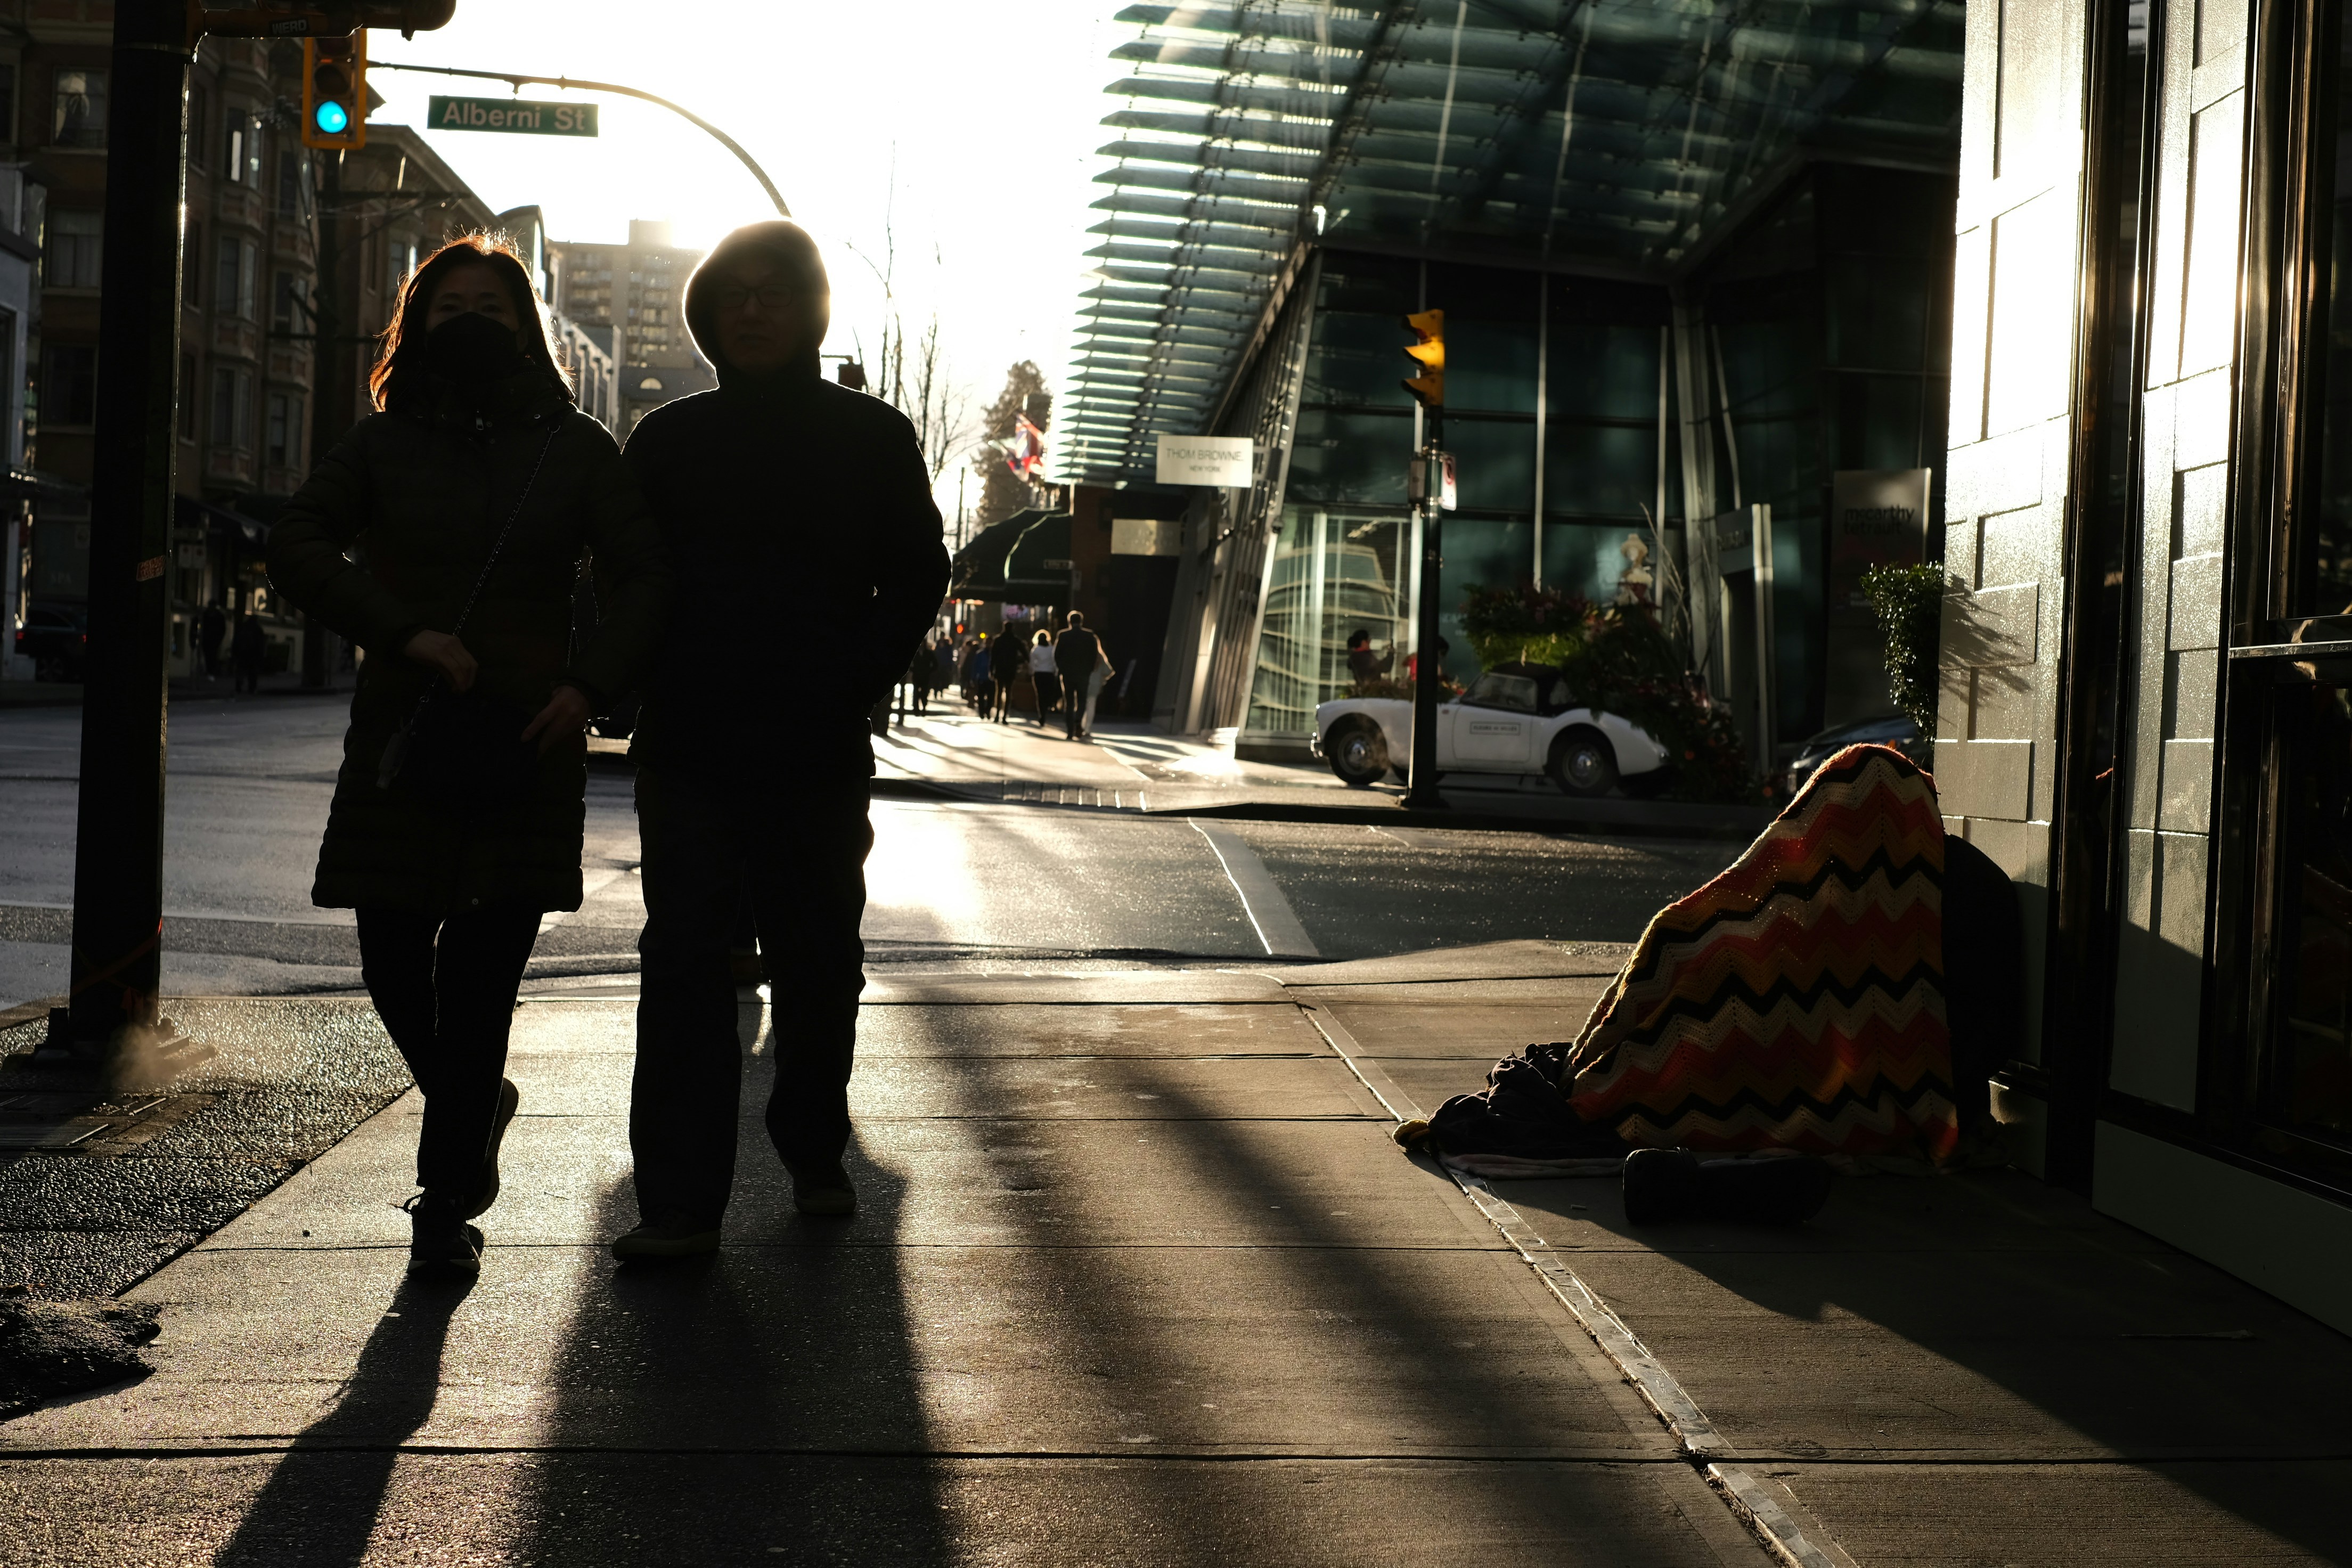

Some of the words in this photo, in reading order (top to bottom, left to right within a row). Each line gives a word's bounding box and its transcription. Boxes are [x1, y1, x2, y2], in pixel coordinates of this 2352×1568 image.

[272, 19, 307, 35] WERD
[442, 101, 541, 128] Alberni
[553, 106, 585, 131] St
[1166, 448, 1195, 460] THOM
[1844, 504, 1915, 522] mccarthy
